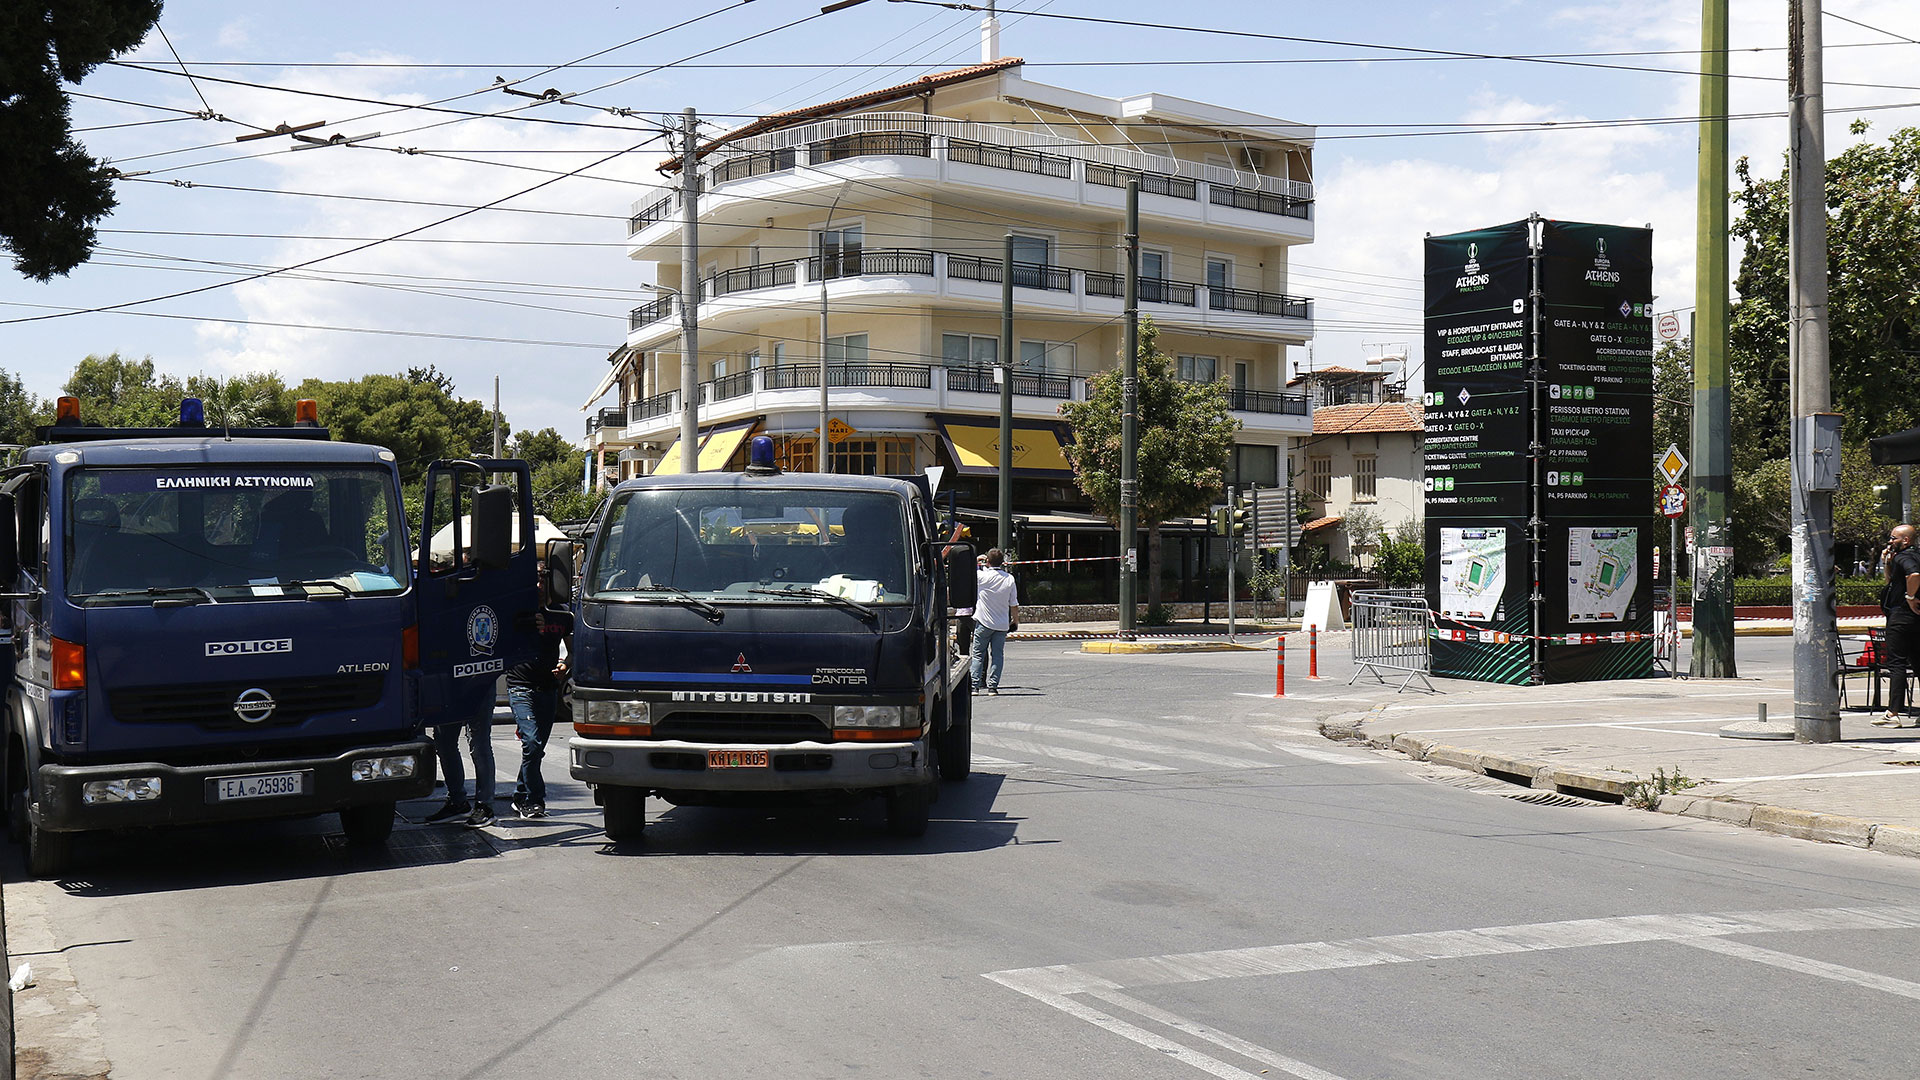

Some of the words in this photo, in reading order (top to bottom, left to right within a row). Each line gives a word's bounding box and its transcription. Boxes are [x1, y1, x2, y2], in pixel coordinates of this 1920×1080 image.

[1456, 274, 1490, 288] ATHENS
[1585, 270, 1620, 282] ATHENS
[1453, 324, 1490, 335] HOSPITALITY
[1491, 320, 1523, 330] ENTRANCE
[1461, 345, 1497, 355] BROADCAST
[1504, 343, 1523, 352] MEDIA
[1491, 352, 1522, 361] ENTRANCE
[1550, 406, 1580, 414] PERISSOS
[156, 477, 231, 488] ΕΛΛΗΝΙΚΗ
[235, 477, 314, 487] ΑΣΤΥΝΟΜΙΑ
[208, 640, 289, 654] POLICE
[337, 663, 390, 673] ATLEON
[456, 660, 502, 676] POLICE
[812, 675, 868, 684] CANTER
[672, 691, 810, 703] MITSUBISHI
[740, 753, 766, 765] 1805
[257, 777, 294, 794] 25936
